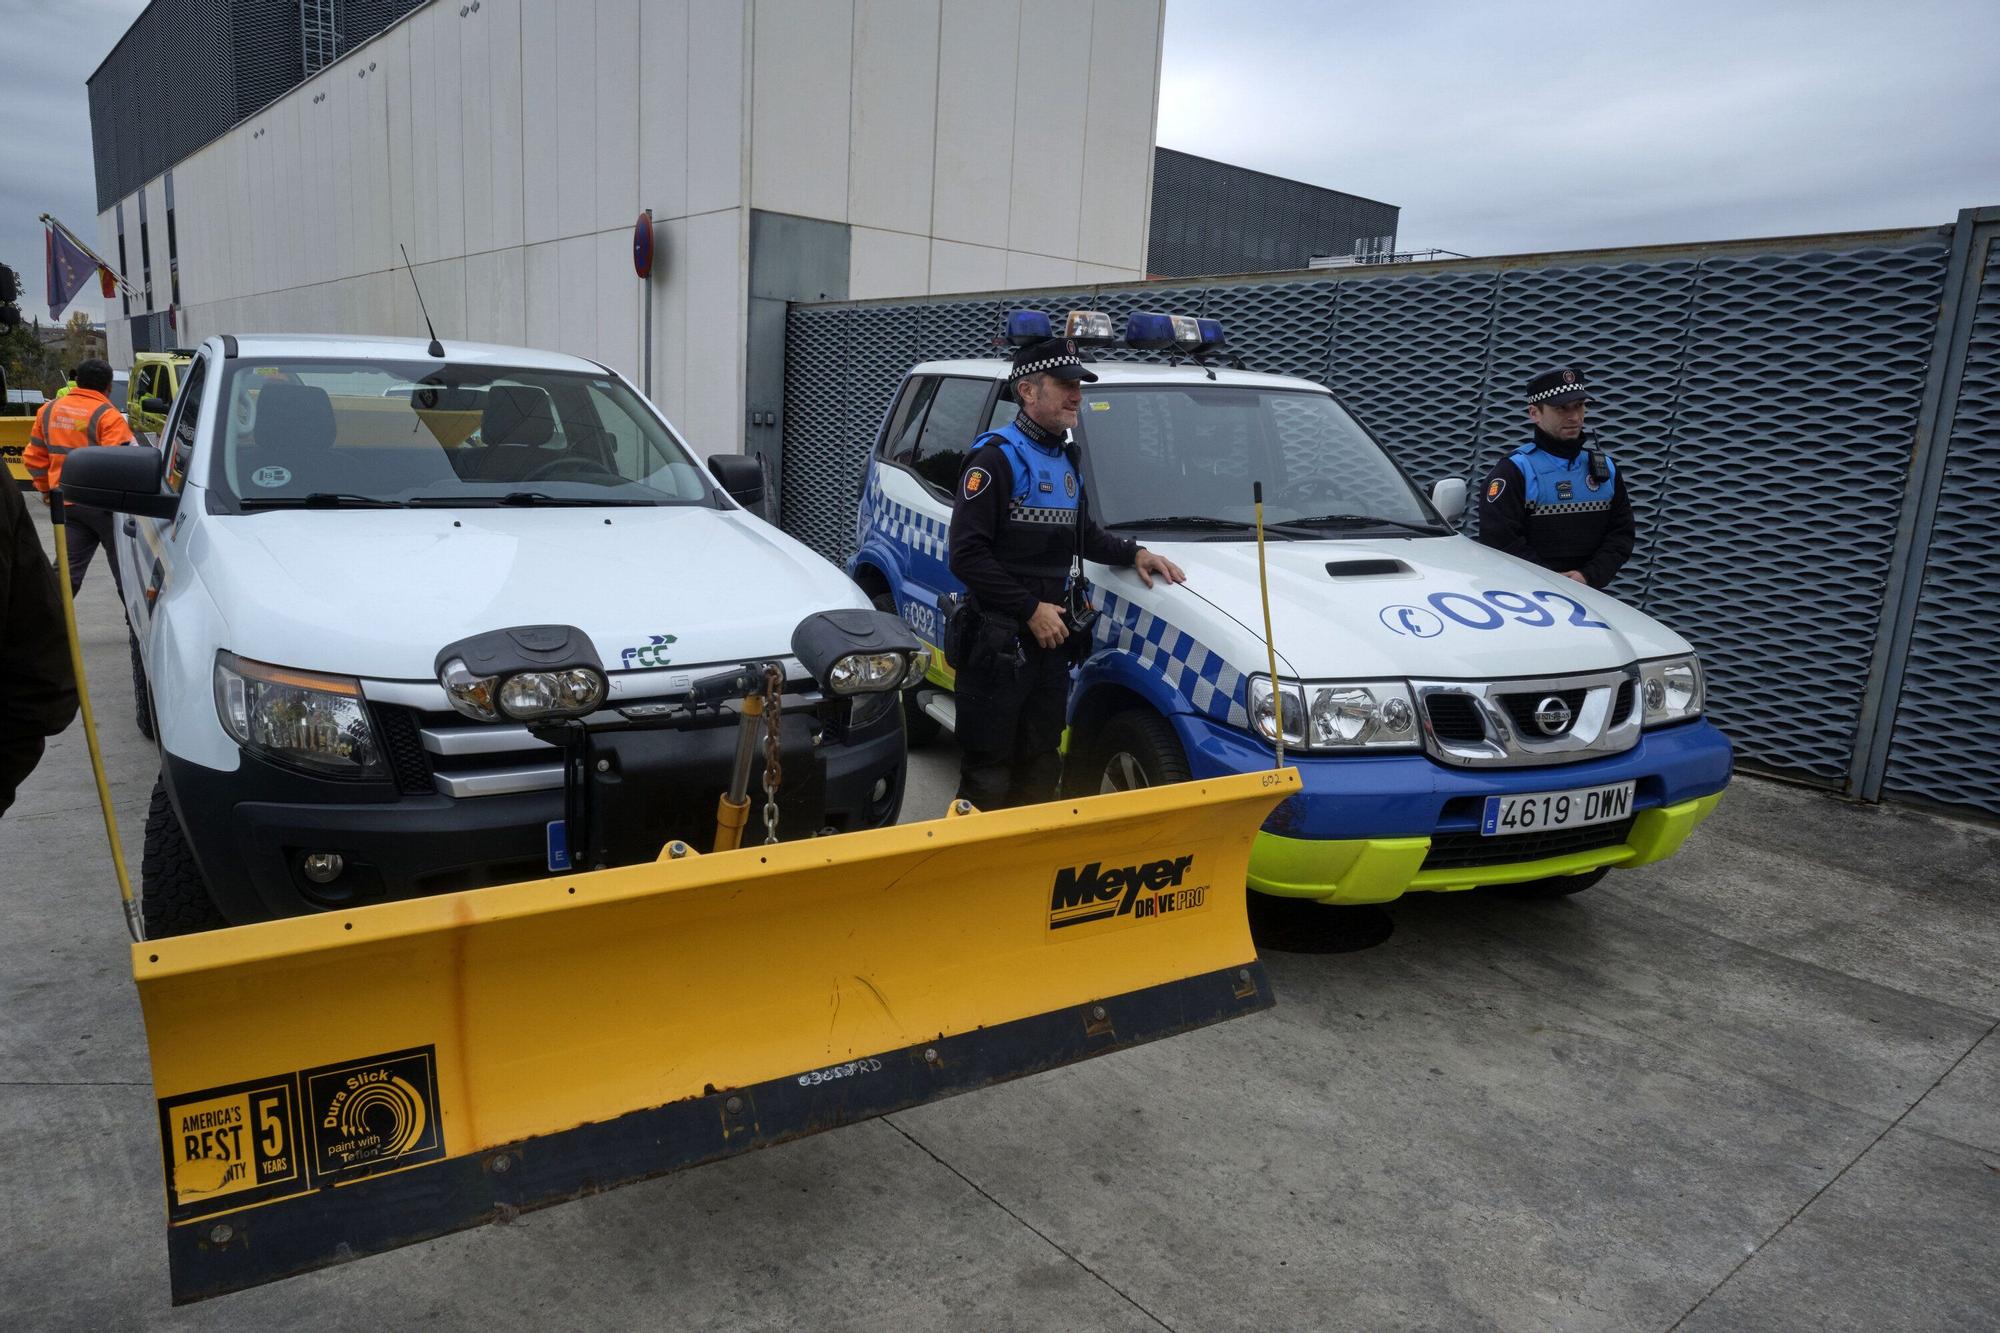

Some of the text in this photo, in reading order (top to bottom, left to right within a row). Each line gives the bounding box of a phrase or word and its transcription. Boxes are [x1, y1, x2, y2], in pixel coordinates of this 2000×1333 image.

[911, 601, 935, 638] 092
[1427, 590, 1612, 630] 092
[621, 645, 672, 669] FCC
[1262, 773, 1281, 788] 602
[1501, 787, 1629, 828] 4619 DWN
[1487, 820, 1494, 829] E
[555, 850, 565, 861] E
[1051, 854, 1194, 916] Meyer
[1135, 887, 1205, 919] DRIVE PRO
[324, 1069, 389, 1128] Dura Slick
[182, 1106, 242, 1133] AMERICA'S
[259, 1097, 284, 1157] 5
[328, 1135, 381, 1157] paint with
[341, 1148, 378, 1163] Teflon
[262, 1157, 287, 1174] YEARS
